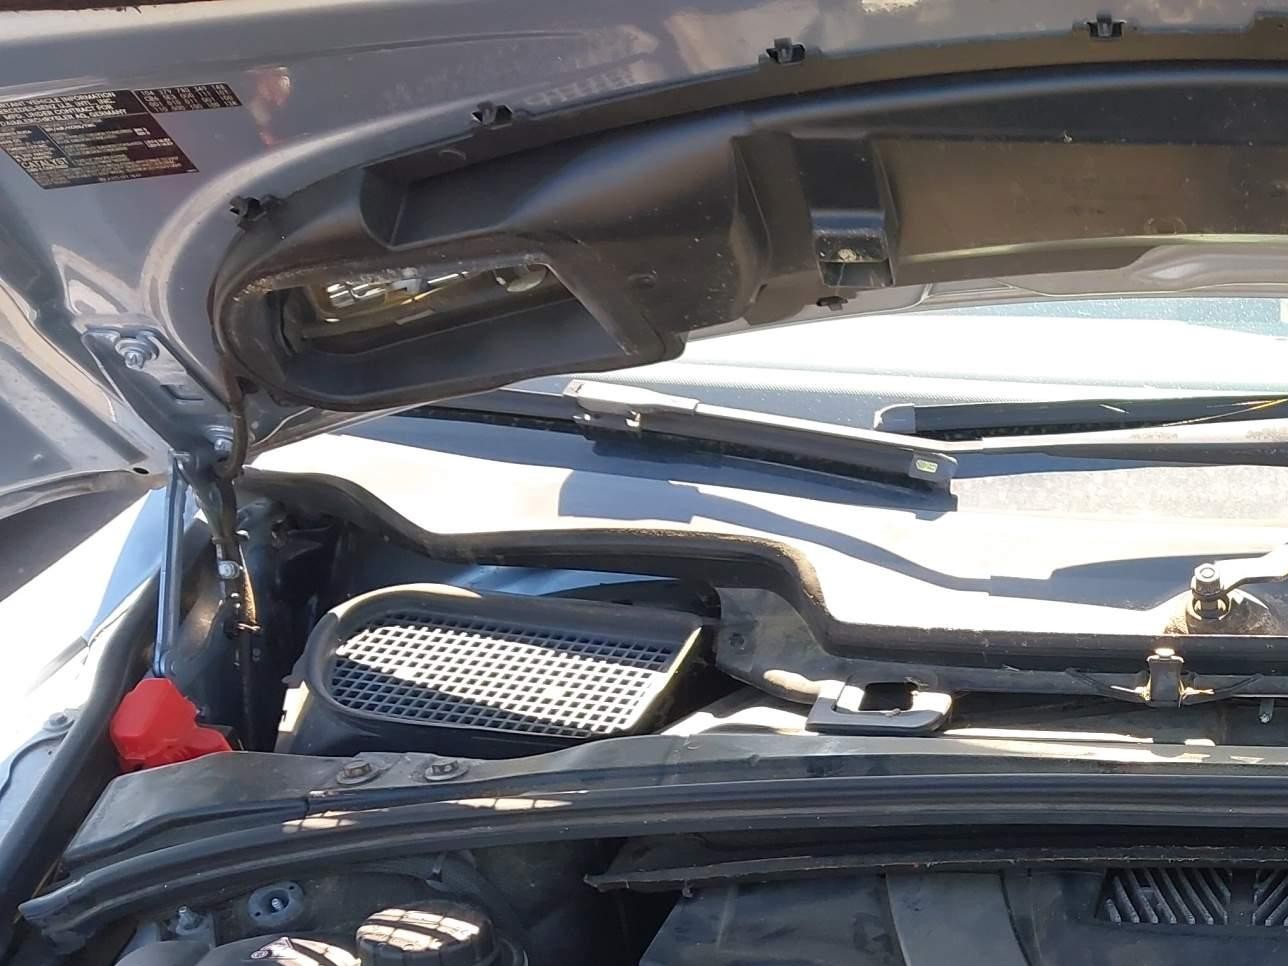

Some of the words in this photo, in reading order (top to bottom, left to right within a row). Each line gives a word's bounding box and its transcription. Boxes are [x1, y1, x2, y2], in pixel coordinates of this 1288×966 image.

[61, 92, 116, 102] INFORMATION
[25, 110, 54, 118] UNDER
[55, 106, 95, 115] CONTRACT
[89, 109, 127, 117] GERMANY
[21, 158, 68, 170] CATALYST
